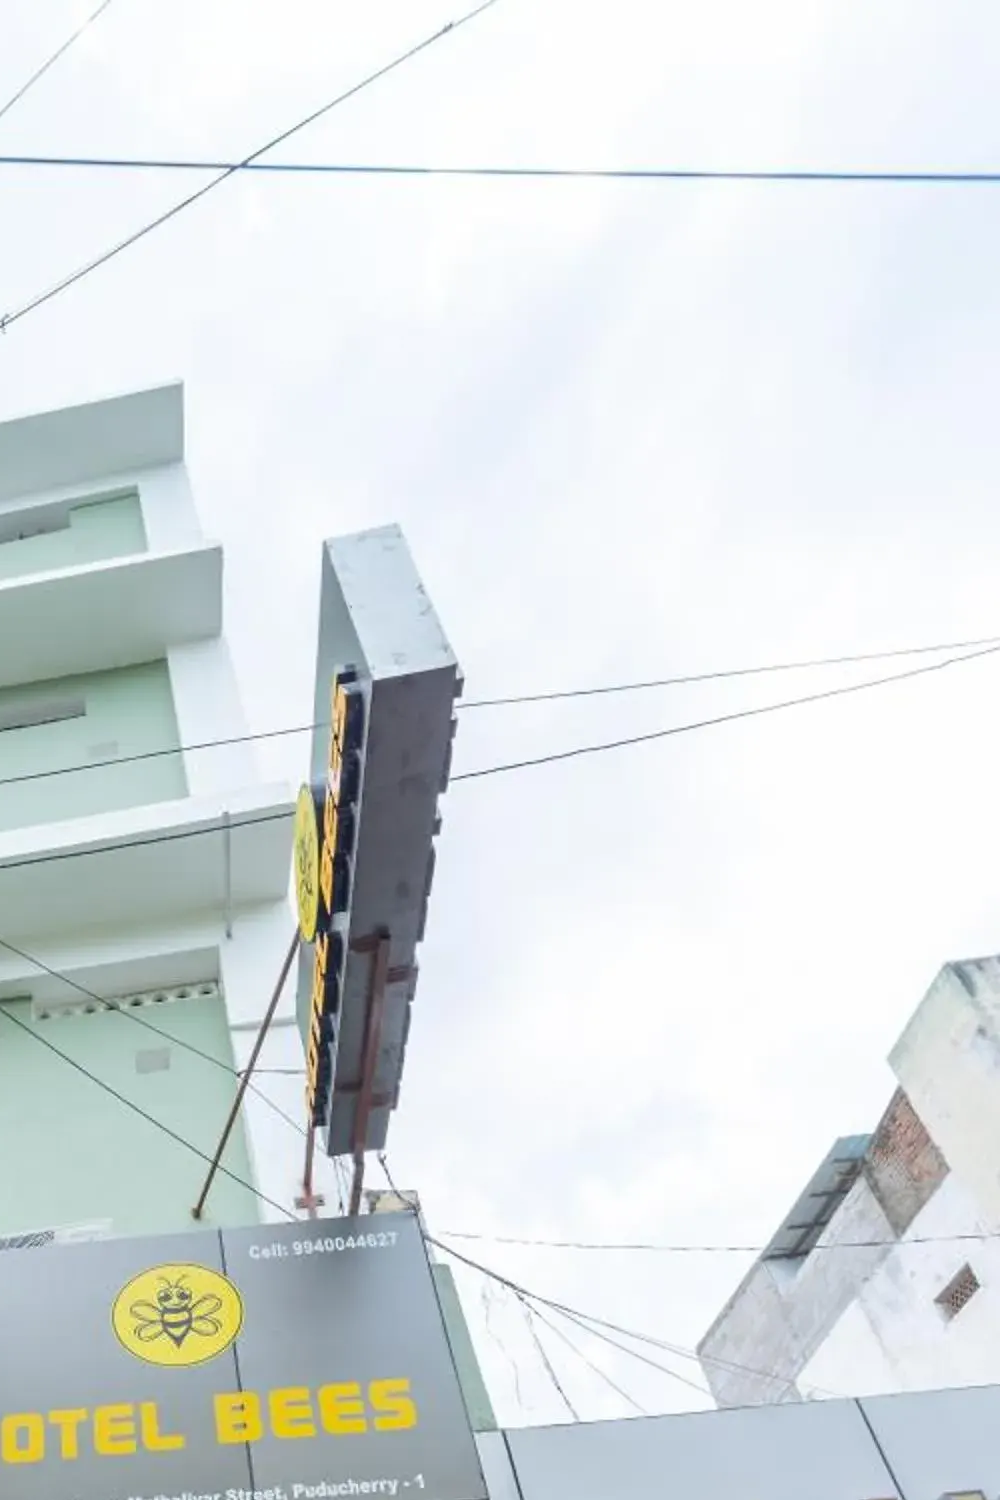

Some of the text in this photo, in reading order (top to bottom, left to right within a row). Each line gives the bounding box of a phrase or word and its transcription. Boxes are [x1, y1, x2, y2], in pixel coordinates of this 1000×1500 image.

[249, 1231, 398, 1259] Cell: 9940044627
[214, 1378, 418, 1444] BEES
[292, 1478, 398, 1500] Puducherry
[413, 1473, 426, 1489] 1
